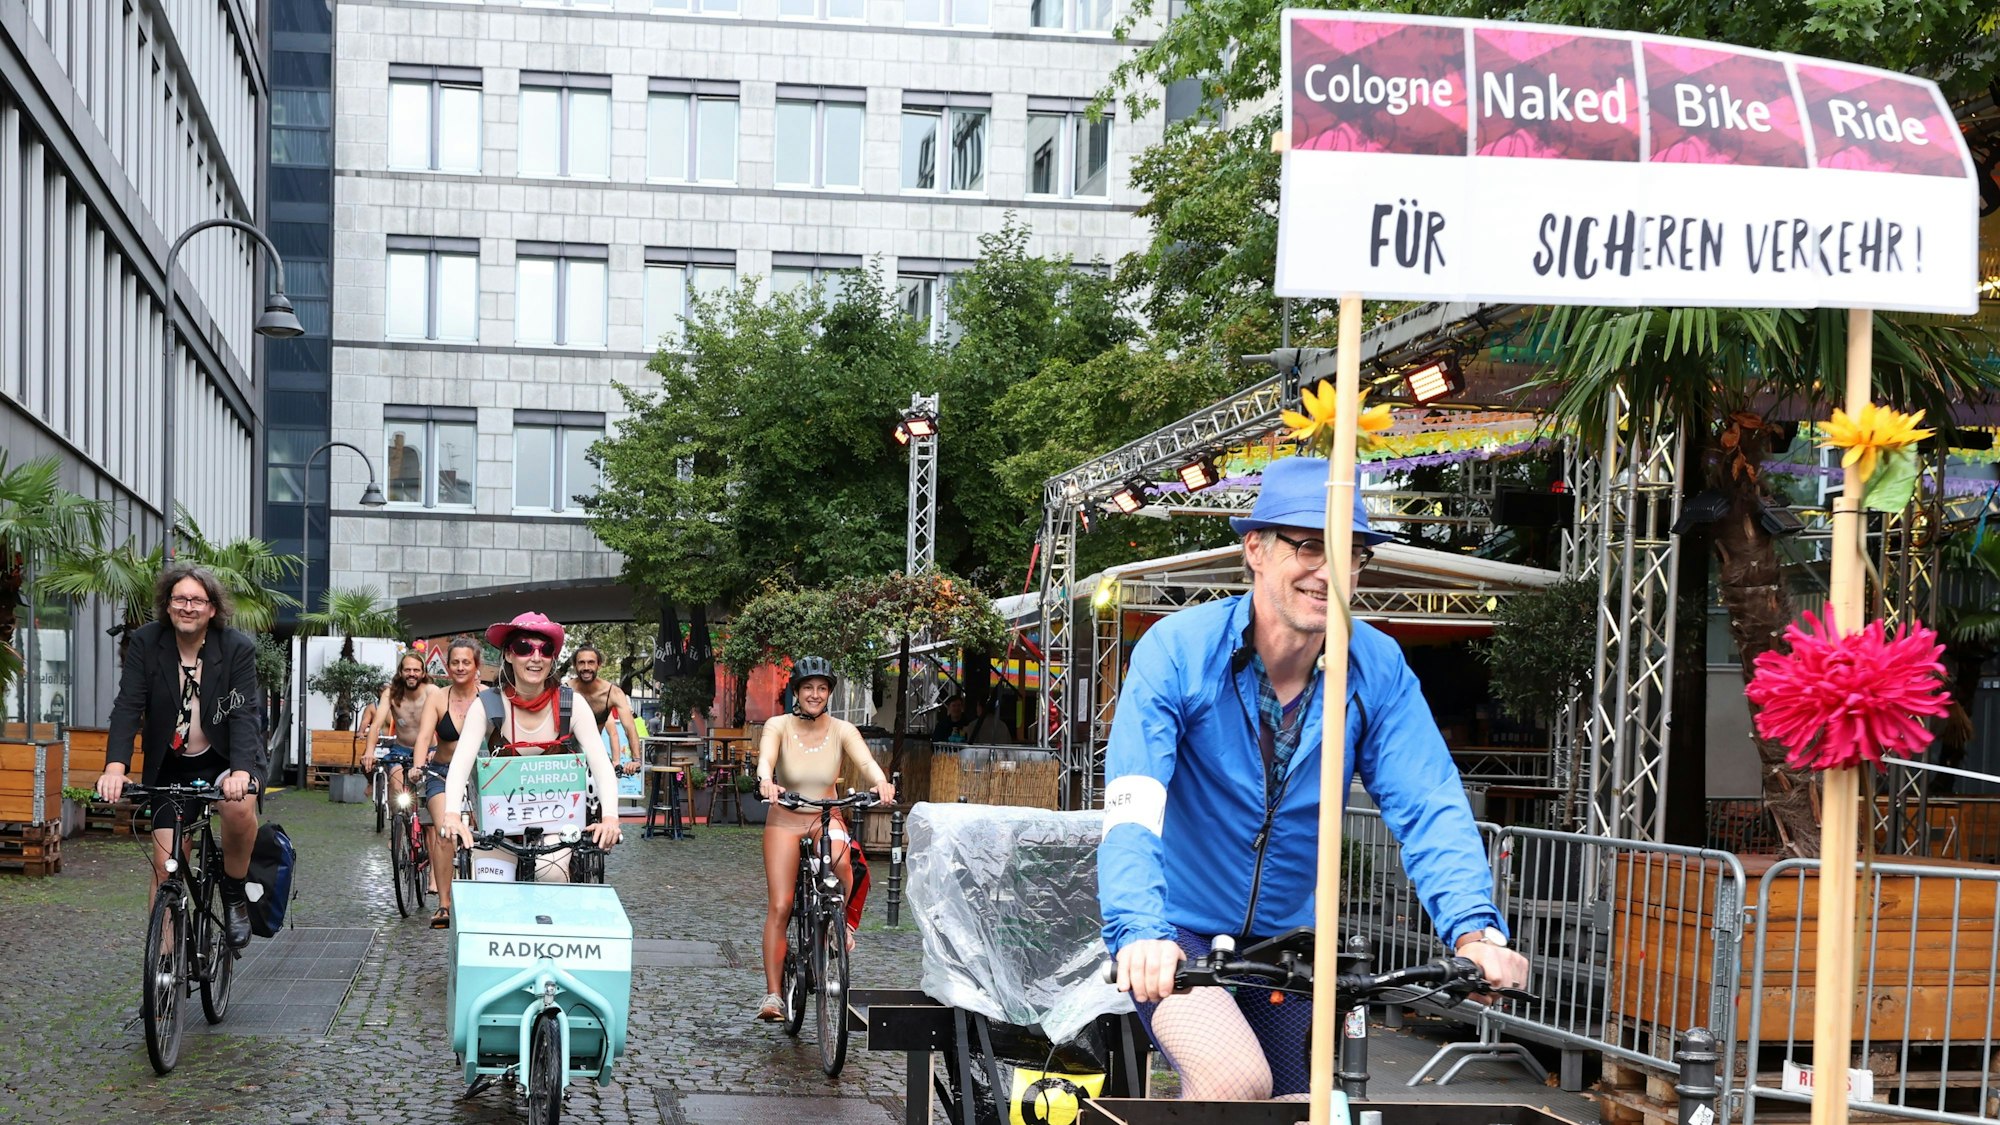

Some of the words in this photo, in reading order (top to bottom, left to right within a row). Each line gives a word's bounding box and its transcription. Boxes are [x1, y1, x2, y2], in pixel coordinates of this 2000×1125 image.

[1304, 63, 1454, 116] Cologne
[1482, 71, 1628, 126] Naked
[1674, 82, 1773, 134] Bike
[1832, 97, 1931, 148] Ride
[1369, 197, 1447, 276] FÜR
[1533, 209, 1724, 281] SICHEREN
[520, 773, 578, 785] FAHRRAD
[477, 866, 504, 876] ORDNER
[488, 941, 602, 959] RADKOMM
